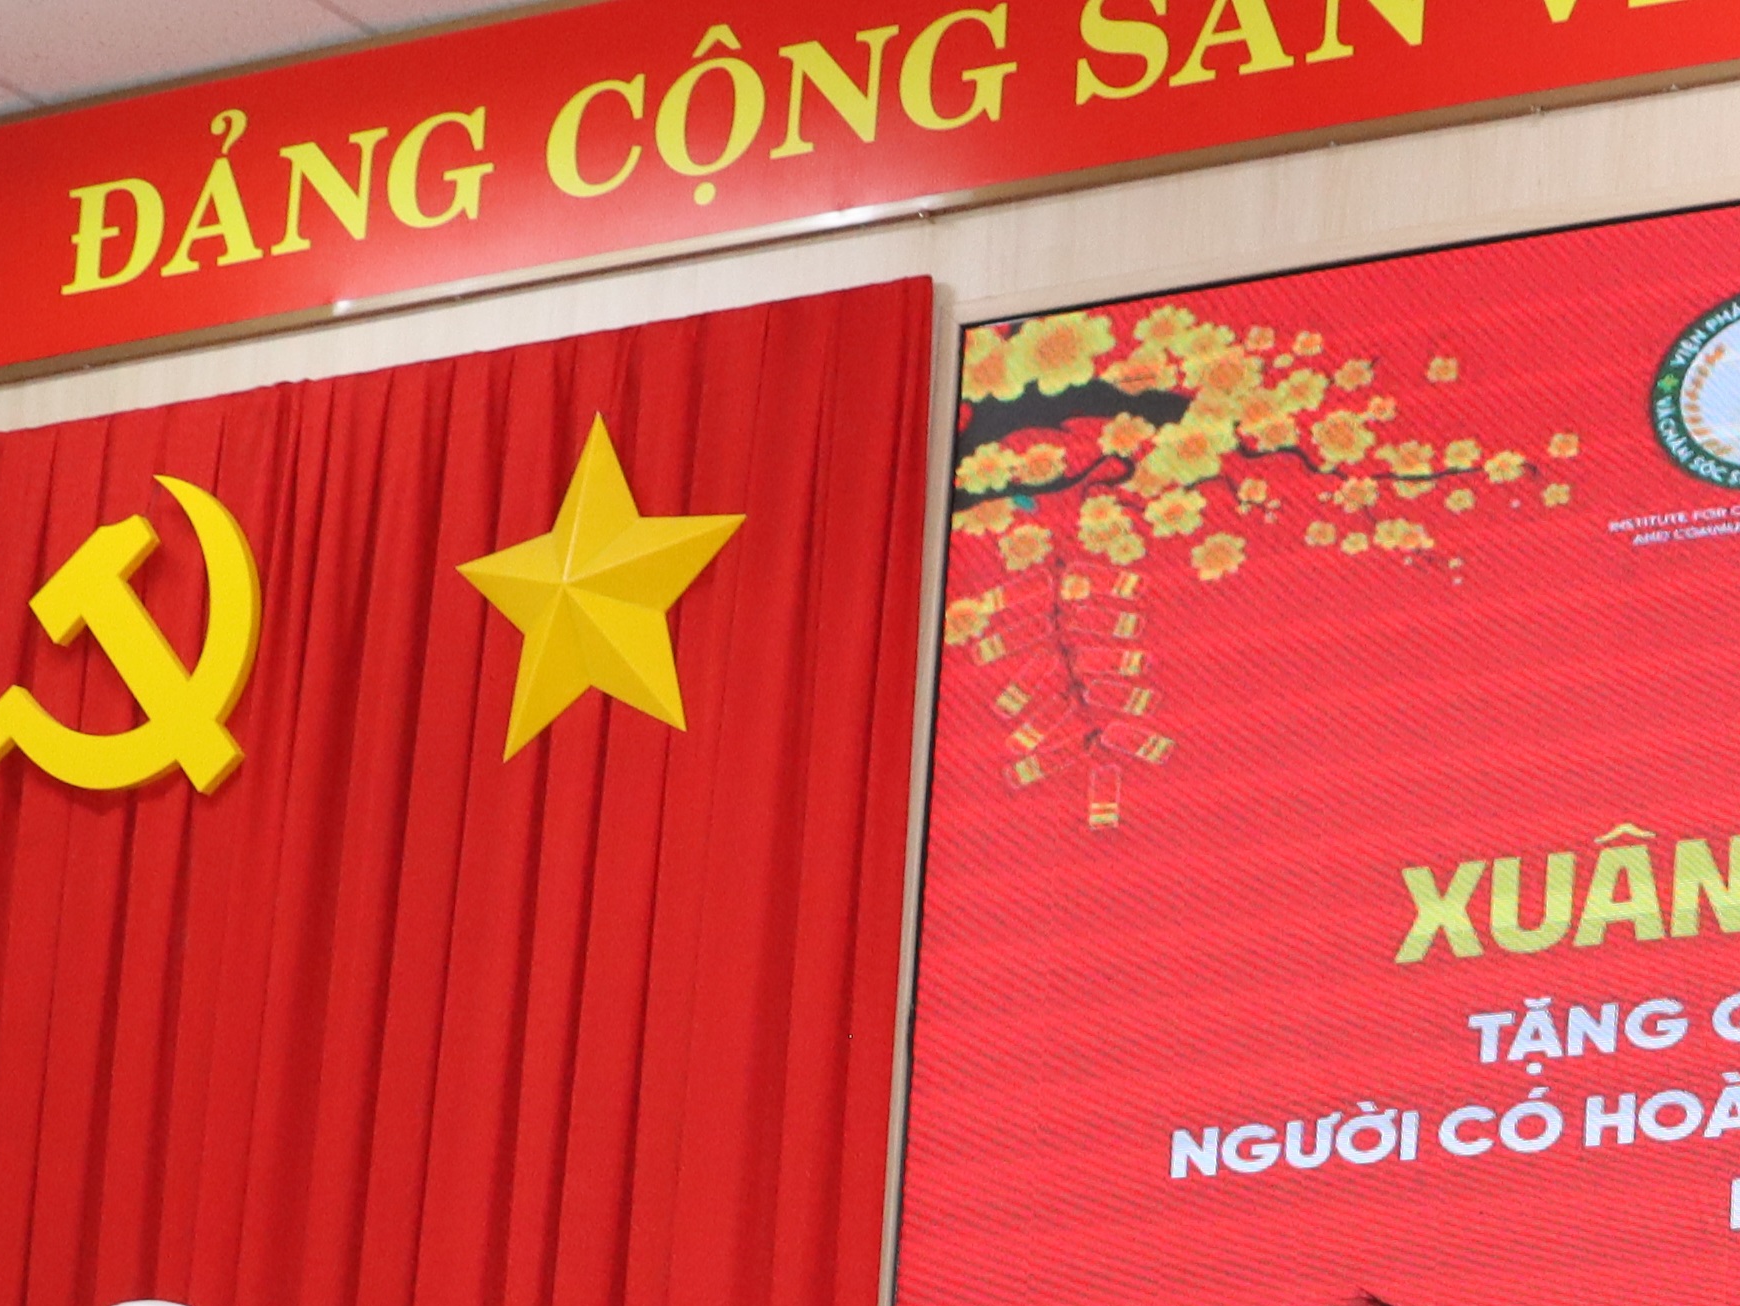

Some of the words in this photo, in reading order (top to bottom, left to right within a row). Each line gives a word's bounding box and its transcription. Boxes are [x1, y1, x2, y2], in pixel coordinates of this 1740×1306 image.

[60, 107, 496, 298] ĐẢNG
[545, 2, 1018, 207] CỘNG
[1468, 996, 1689, 1076] TẶNG
[1170, 1101, 1419, 1179] NGƯỜI
[1438, 1086, 1564, 1157] CÓ
